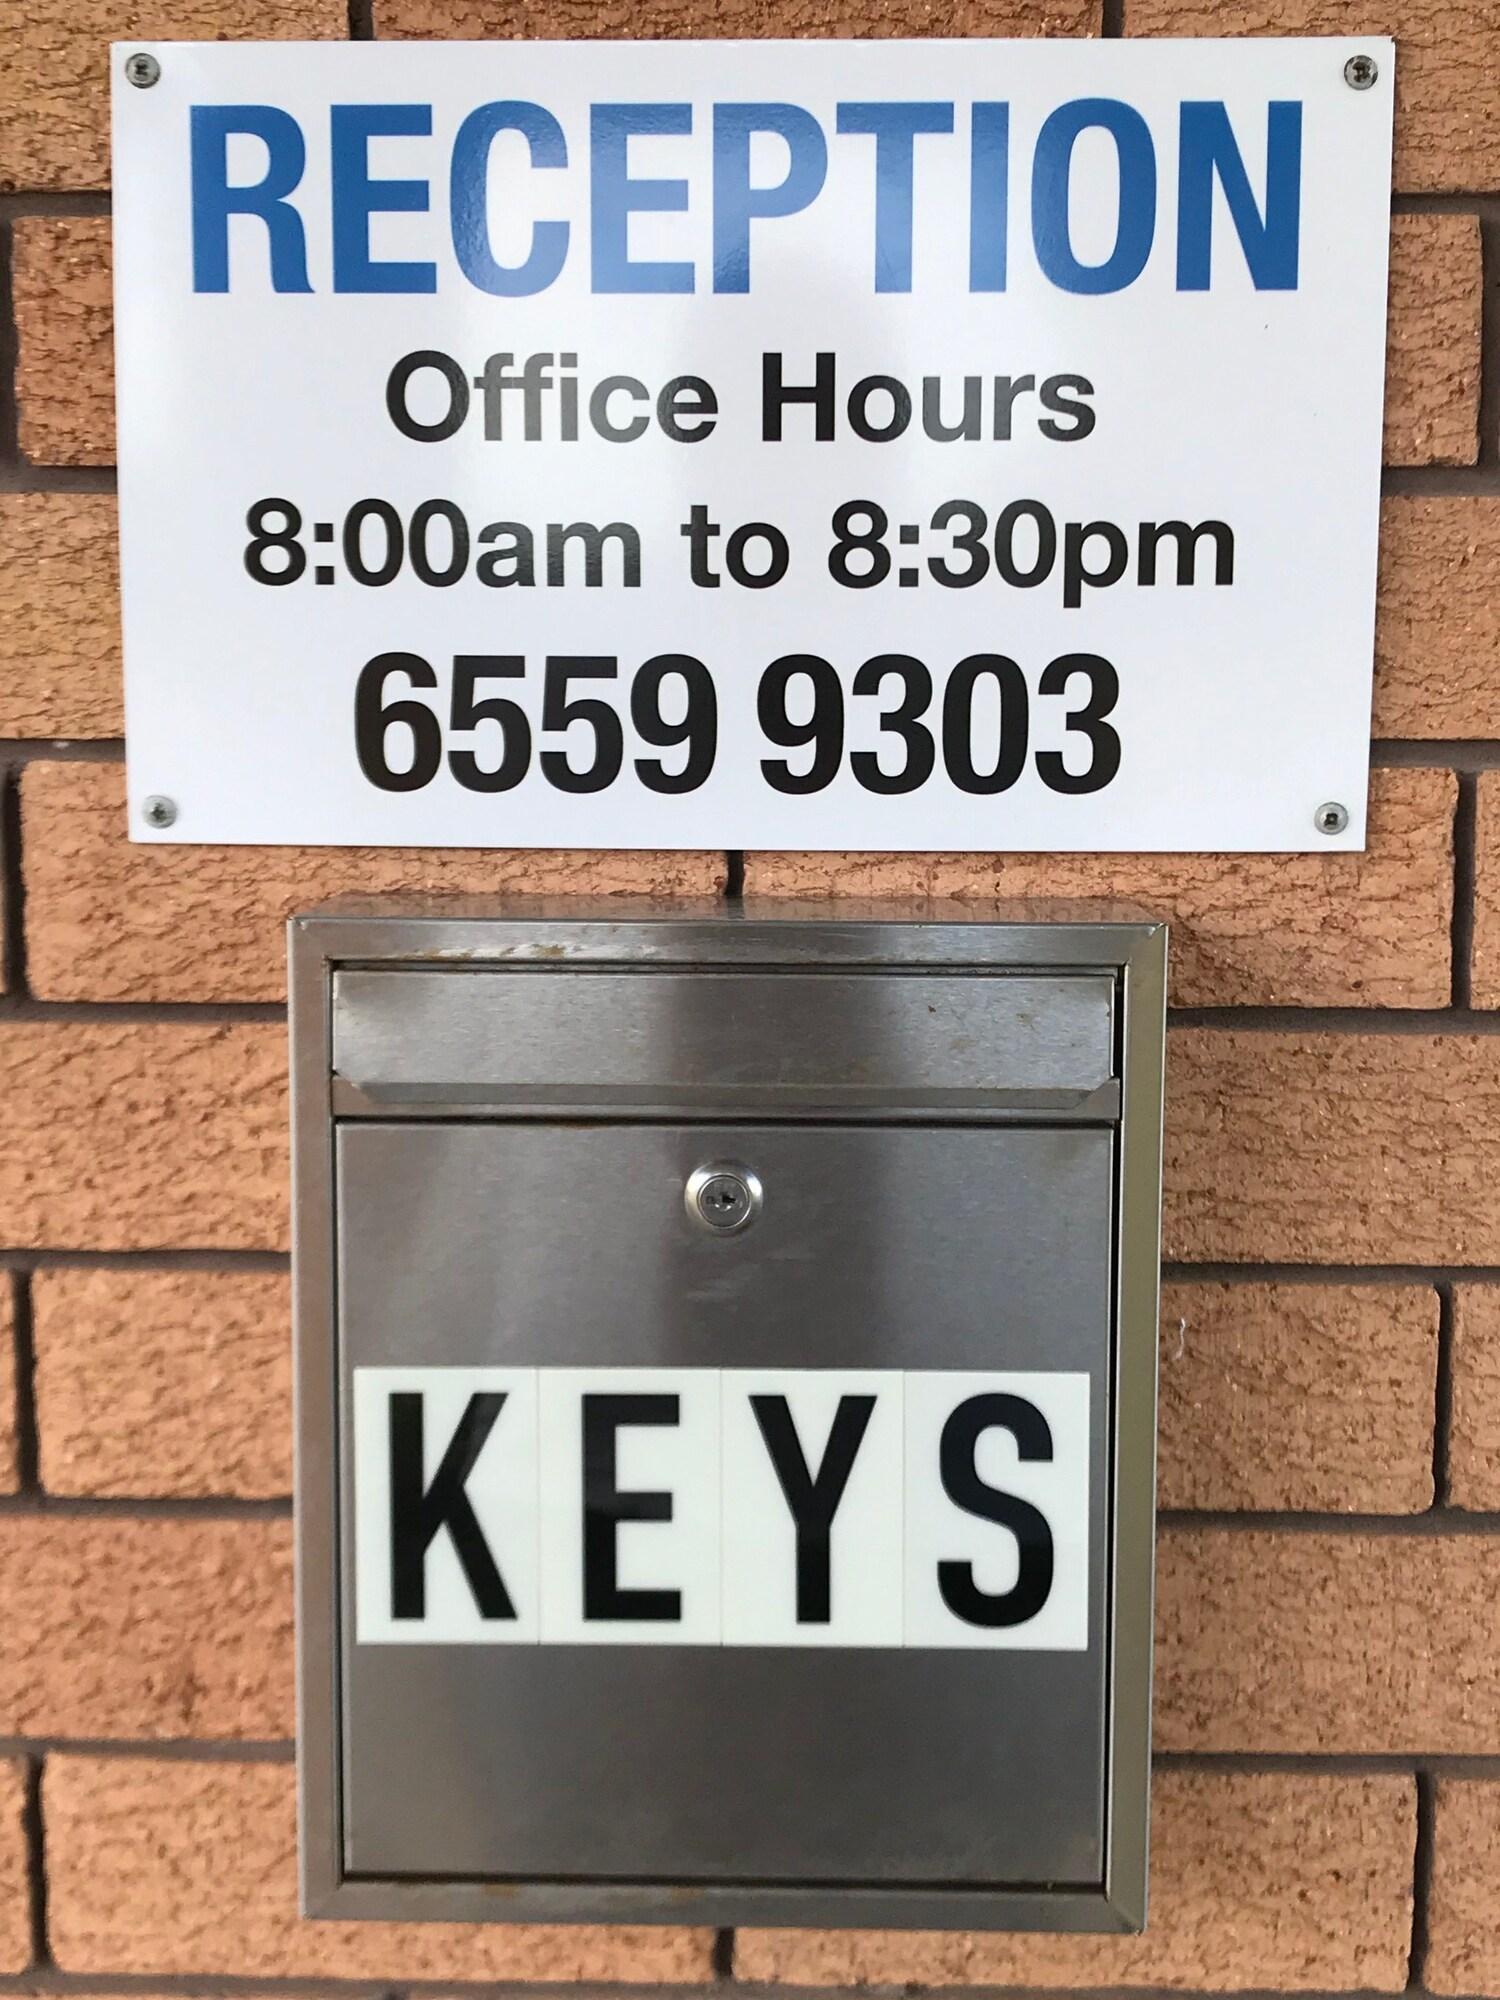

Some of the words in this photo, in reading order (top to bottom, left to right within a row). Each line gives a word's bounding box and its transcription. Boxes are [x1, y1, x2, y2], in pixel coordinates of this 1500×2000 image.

[190, 97, 1303, 296] RECEPTION
[385, 349, 718, 444] Office
[762, 352, 1097, 444] Hours
[243, 497, 641, 589] 8:00am
[679, 504, 791, 590] to
[827, 498, 1236, 610] 8:30pm
[354, 651, 718, 795] 6559
[756, 652, 1122, 796] 9303
[388, 1391, 1055, 1630] KEYS
